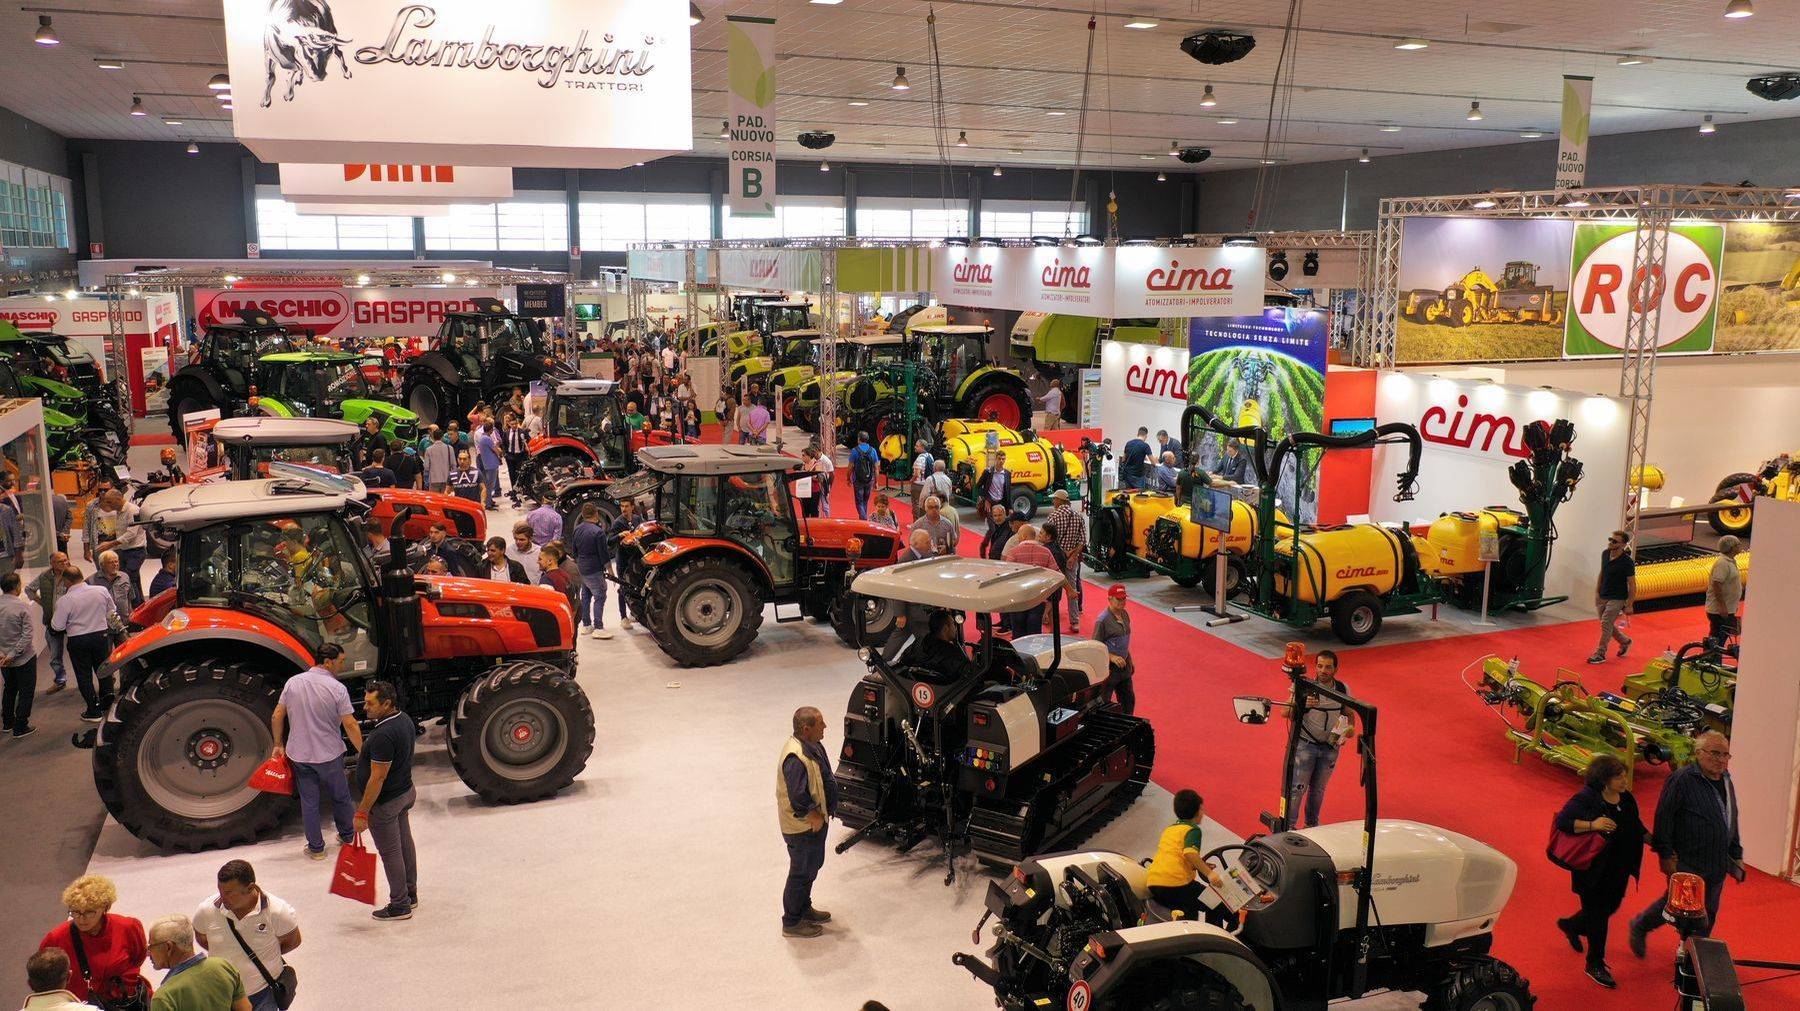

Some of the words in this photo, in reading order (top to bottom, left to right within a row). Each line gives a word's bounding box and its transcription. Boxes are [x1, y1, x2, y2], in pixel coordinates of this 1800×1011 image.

[354, 4, 656, 88] Lamborghini
[564, 79, 645, 92] TRATTORI
[737, 115, 768, 129] PAD.
[730, 129, 775, 143] NUOVO
[731, 150, 774, 162] CORSIA
[1561, 152, 1580, 162] PAD.
[1556, 163, 1584, 173] NUOVO
[742, 167, 763, 198] B
[953, 256, 993, 284] cima
[1041, 257, 1091, 289] cima
[1146, 259, 1234, 292] cima
[1579, 262, 1711, 315] ROC
[218, 299, 342, 318] MASCHIO
[524, 300, 548, 309] MEMBER
[0, 311, 57, 321] MASCHIO
[353, 300, 480, 325] GASPAR
[1205, 330, 1250, 341] TECNOLOGIA
[1254, 334, 1279, 344] SENZA
[1282, 338, 1309, 346] LIMITE
[1420, 394, 1553, 459] cim
[450, 473, 479, 485] EA7
[1009, 469, 1031, 479] ima
[1210, 532, 1234, 543] cia
[1440, 556, 1456, 567] ma
[1336, 566, 1376, 580] cima
[919, 689, 928, 700] 15
[1073, 991, 1085, 1009] 40
